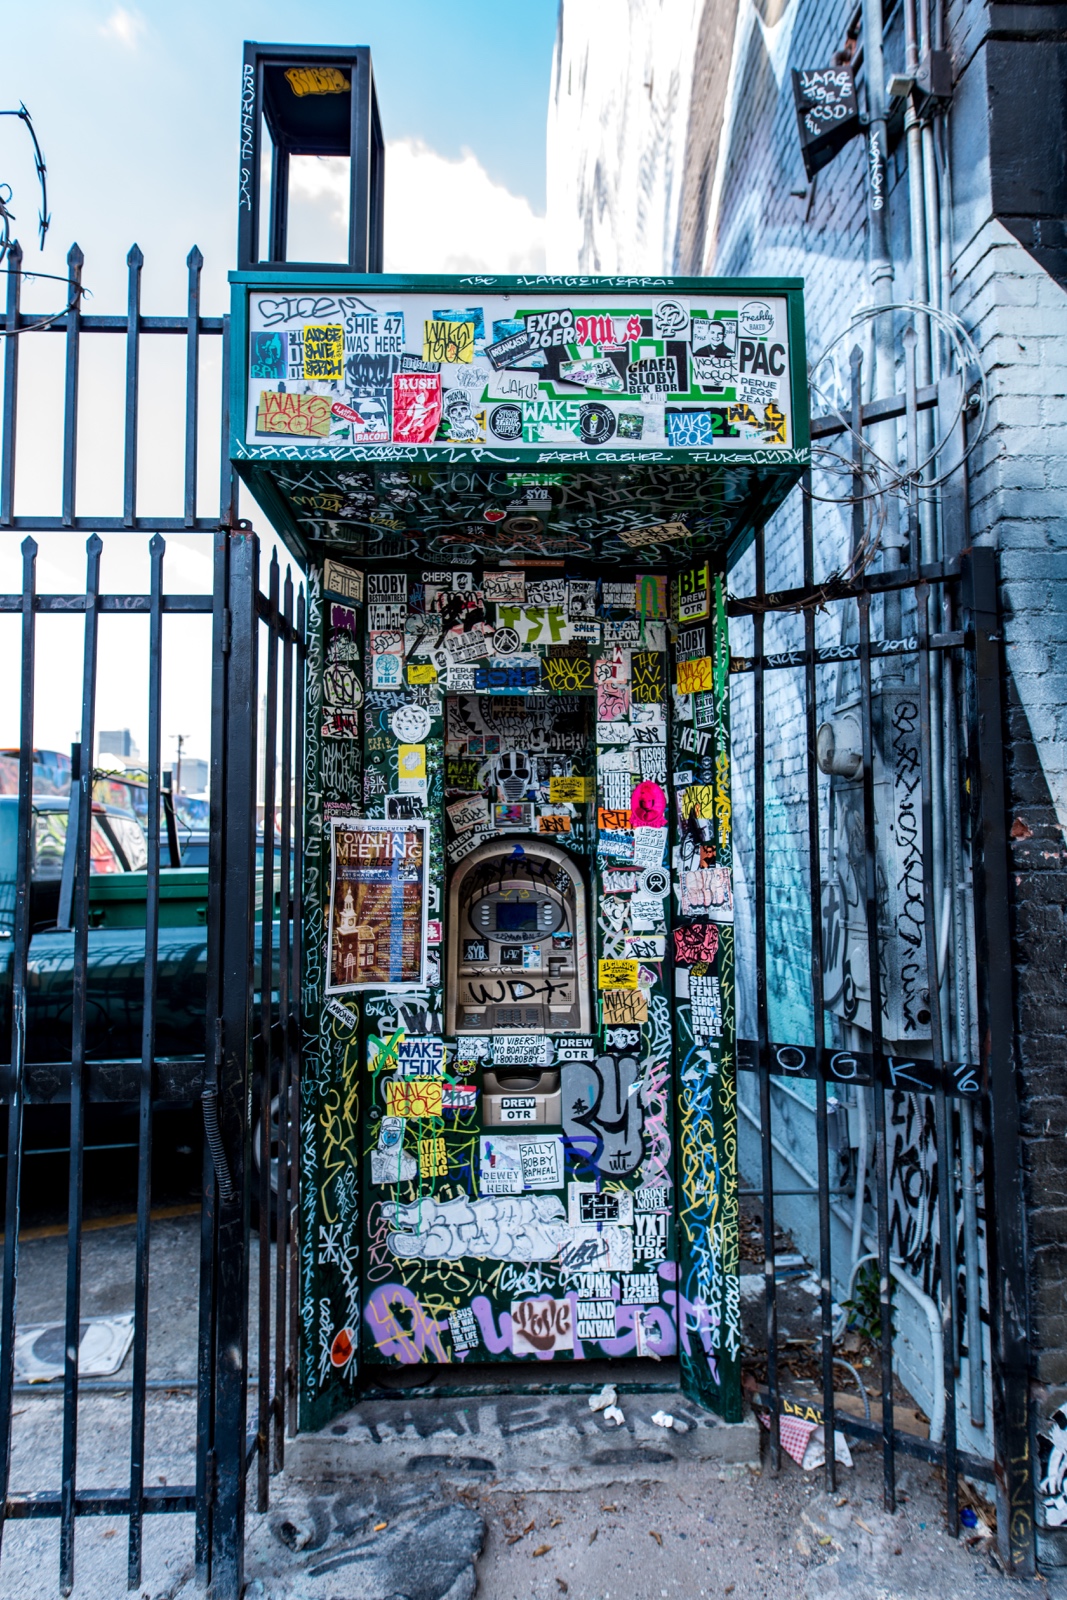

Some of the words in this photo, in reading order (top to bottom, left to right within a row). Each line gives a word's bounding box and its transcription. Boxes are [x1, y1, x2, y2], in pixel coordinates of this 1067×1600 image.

[526, 310, 573, 333] EXPO
[739, 310, 775, 326] Freshly
[346, 317, 378, 334] SHIE
[383, 317, 401, 333] 47
[346, 336, 369, 352] WAS
[374, 336, 401, 352] HERE
[529, 328, 576, 349] 26ER
[627, 358, 676, 372] CHAFA
[739, 341, 786, 377] PAC
[398, 377, 437, 390] RUSH
[627, 372, 676, 386] SLOBY
[740, 377, 778, 390] PERUE
[629, 385, 650, 394] BEK
[743, 387, 773, 397] LEGS
[523, 401, 580, 421] WAKS
[356, 433, 387, 441] BACON
[421, 572, 453, 582] CHEPS
[680, 568, 707, 593] BE
[368, 575, 405, 594] SLOBY
[681, 591, 707, 605] DREW
[684, 603, 703, 615] OTR
[604, 630, 640, 640] KAPOW
[676, 628, 704, 654] SLOBY
[766, 651, 801, 667] RICK
[876, 638, 918, 651] 2016
[680, 726, 712, 756] KENT
[603, 773, 632, 785] TUXER
[603, 786, 632, 798] TUXER
[603, 798, 632, 810] TUXER
[474, 824, 494, 832] DRE
[336, 832, 423, 845] TOWNHALL
[446, 830, 472, 852] DREW
[336, 843, 423, 858] MEETING
[456, 841, 476, 858] OTR
[338, 858, 352, 866] LOS
[353, 858, 395, 866] ANGELES
[690, 976, 720, 986] SHIE
[691, 996, 722, 1007] SERCH
[692, 1016, 722, 1026] DEVO
[692, 1025, 724, 1037] PREL
[494, 1037, 504, 1045] NO
[560, 1038, 593, 1048] DREW
[399, 1042, 443, 1058] WAKS
[494, 1046, 504, 1054] NO
[506, 1044, 546, 1055] BOATSHOES
[564, 1050, 588, 1059] OTR
[502, 1098, 536, 1108] DREW
[507, 1110, 531, 1119] OTR
[522, 1144, 554, 1157] SALLY
[523, 1156, 554, 1168] BOBBY
[484, 1172, 518, 1180] DEWEY
[524, 1166, 556, 1178] RAPHEAL
[487, 1184, 516, 1193] HERL
[634, 1214, 666, 1236] YX1
[634, 1236, 666, 1247] U5F
[634, 1247, 666, 1259] TBK
[578, 1273, 612, 1288] YUNX
[621, 1273, 659, 1287] YUNX
[596, 1288, 612, 1298] TBK
[622, 1286, 660, 1298] 125ER
[448, 1307, 473, 1321] JESUS
[577, 1301, 616, 1319] WAND
[449, 1321, 461, 1330] THE
[460, 1318, 474, 1326] WAY
[452, 1334, 464, 1344] THE
[464, 1330, 478, 1341] LIFE
